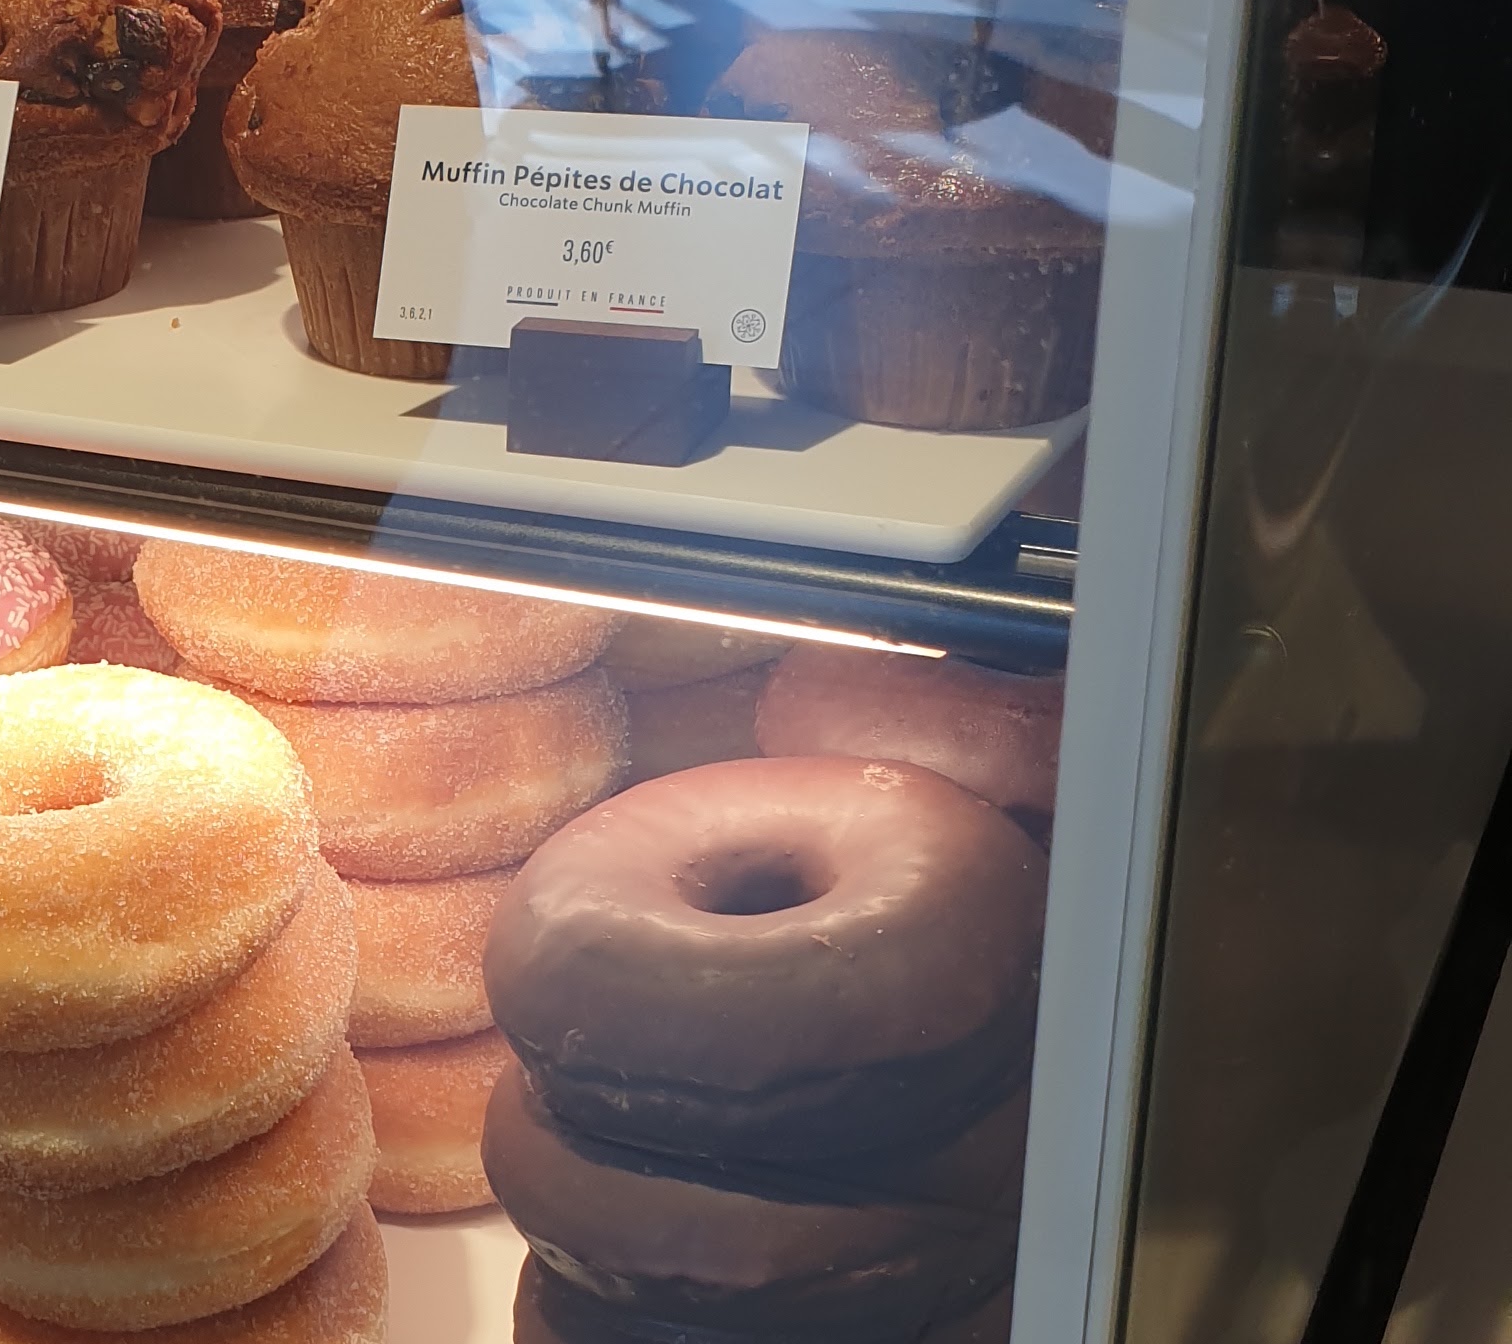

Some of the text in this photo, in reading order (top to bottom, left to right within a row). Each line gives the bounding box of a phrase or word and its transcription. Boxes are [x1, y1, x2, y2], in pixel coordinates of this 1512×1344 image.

[421, 160, 784, 200] Muffin Pépites de Chocolat
[499, 192, 691, 217] Chocolate Chunk Muffin
[562, 239, 614, 265] 3,60€
[507, 286, 666, 307] PRODUIT EN FRANCE
